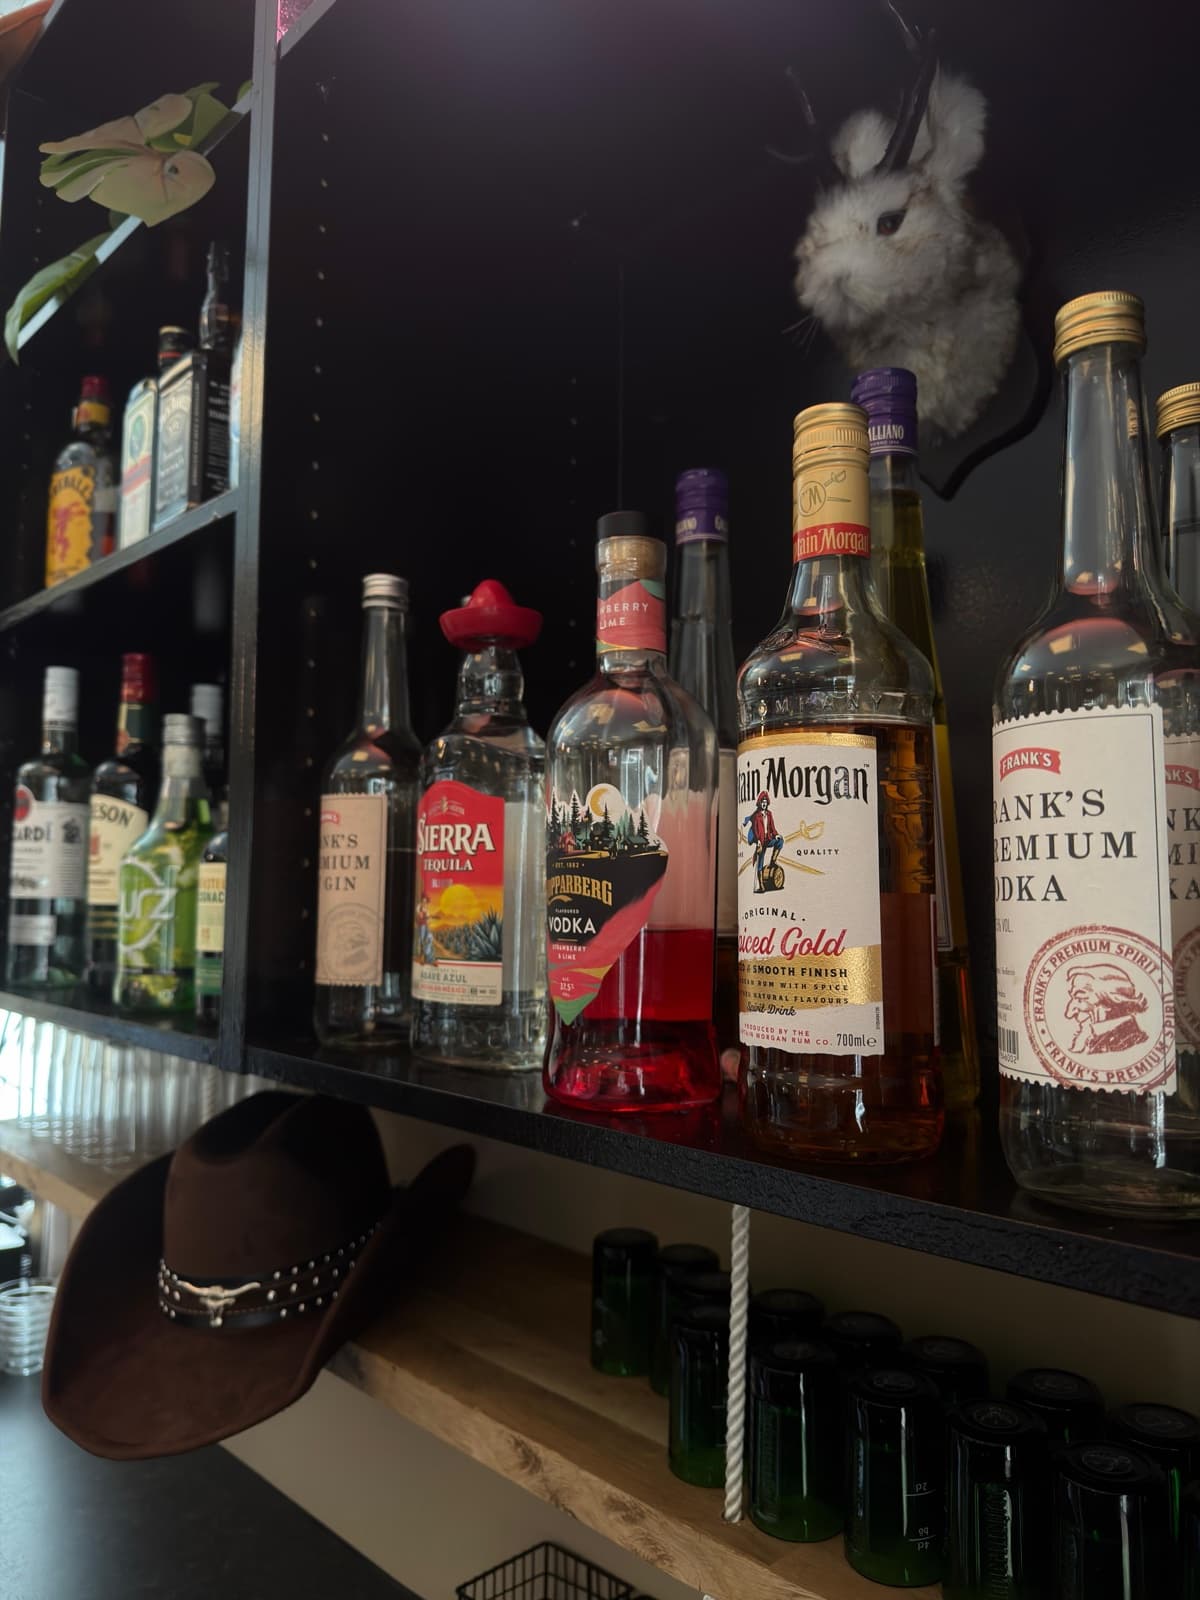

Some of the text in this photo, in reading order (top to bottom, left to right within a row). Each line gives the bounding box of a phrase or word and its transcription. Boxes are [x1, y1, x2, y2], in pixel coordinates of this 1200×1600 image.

[817, 528, 868, 554] Morgan
[1002, 751, 1052, 774] FRANK'S
[762, 757, 868, 805] Morgan
[417, 812, 495, 855] SIERRA
[424, 859, 473, 872] TEQUILA
[324, 876, 357, 891] GIN
[744, 907, 796, 921] ORIGINAL
[549, 916, 596, 935] VODKA
[781, 927, 847, 961] Gold
[443, 974, 467, 984] AZUL
[753, 965, 795, 976] SMOOTH
[801, 967, 847, 978] FINISH
[1034, 966, 1051, 1023] FRANK'S
[1049, 939, 1111, 967] PREMIUM
[1115, 943, 1159, 975] SPIRIT
[753, 993, 788, 1001] NATURAL
[767, 1004, 797, 1016] Drink
[756, 1033, 787, 1042] MORGAN
[791, 1037, 811, 1045] RUM
[1044, 1041, 1099, 1081] FRANK'S
[1106, 1044, 1169, 1083] PREMIUM
